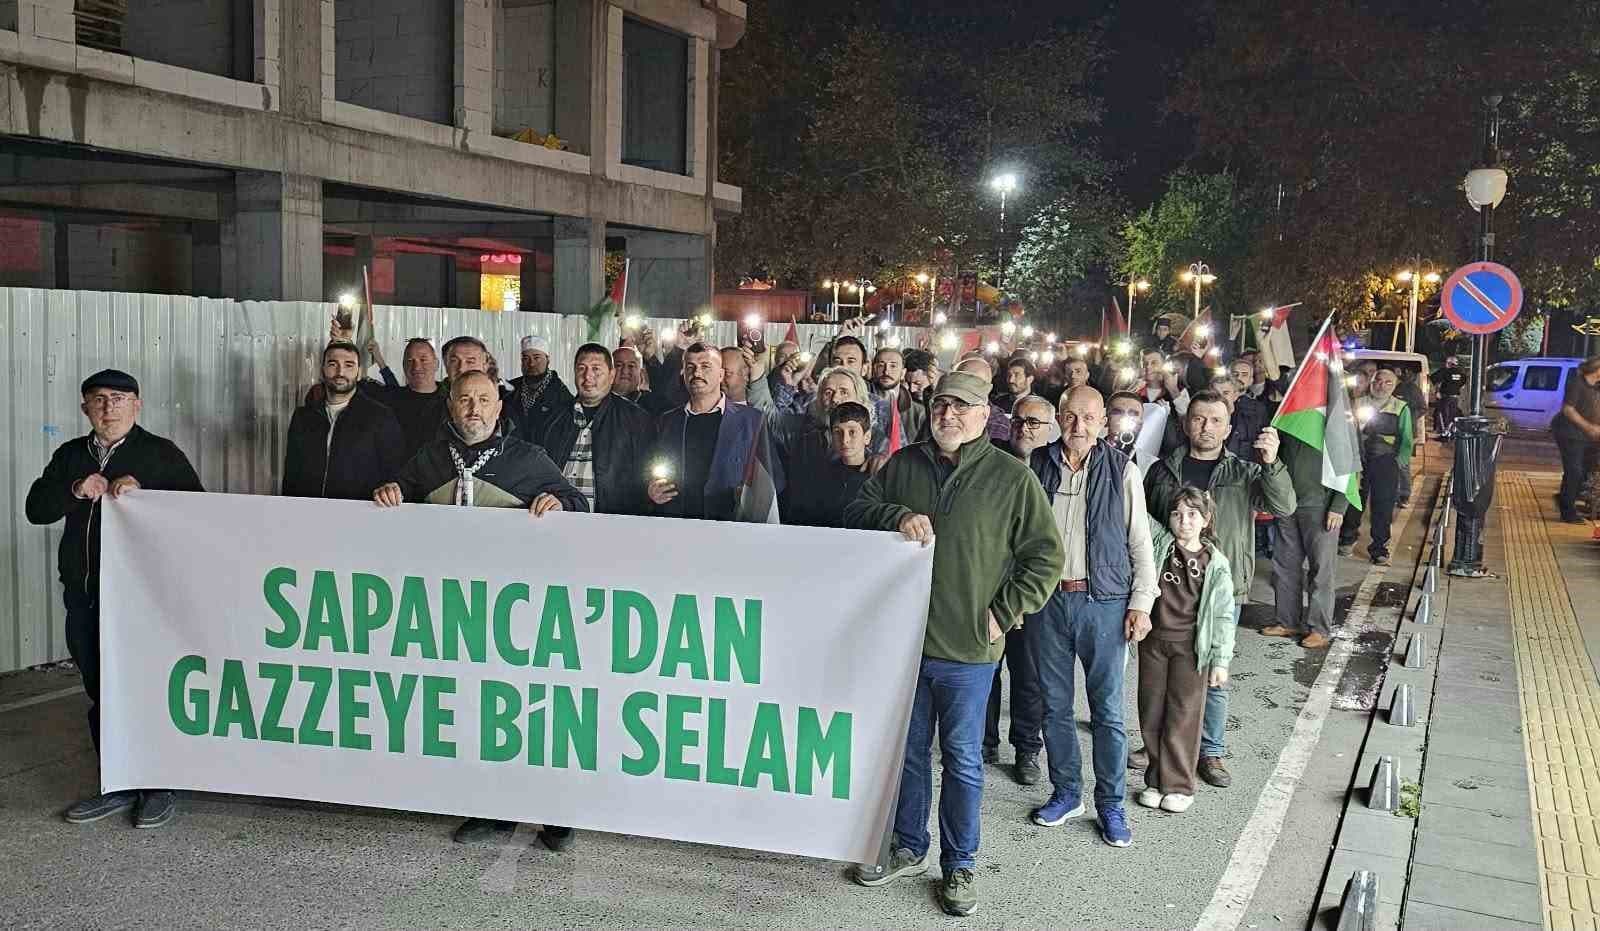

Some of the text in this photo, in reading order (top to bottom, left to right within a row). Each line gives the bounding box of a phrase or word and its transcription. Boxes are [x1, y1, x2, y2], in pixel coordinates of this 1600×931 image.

[263, 566, 763, 685] SAPANCA'DAN
[168, 654, 853, 801] GAZZEYE BİN SELAM
